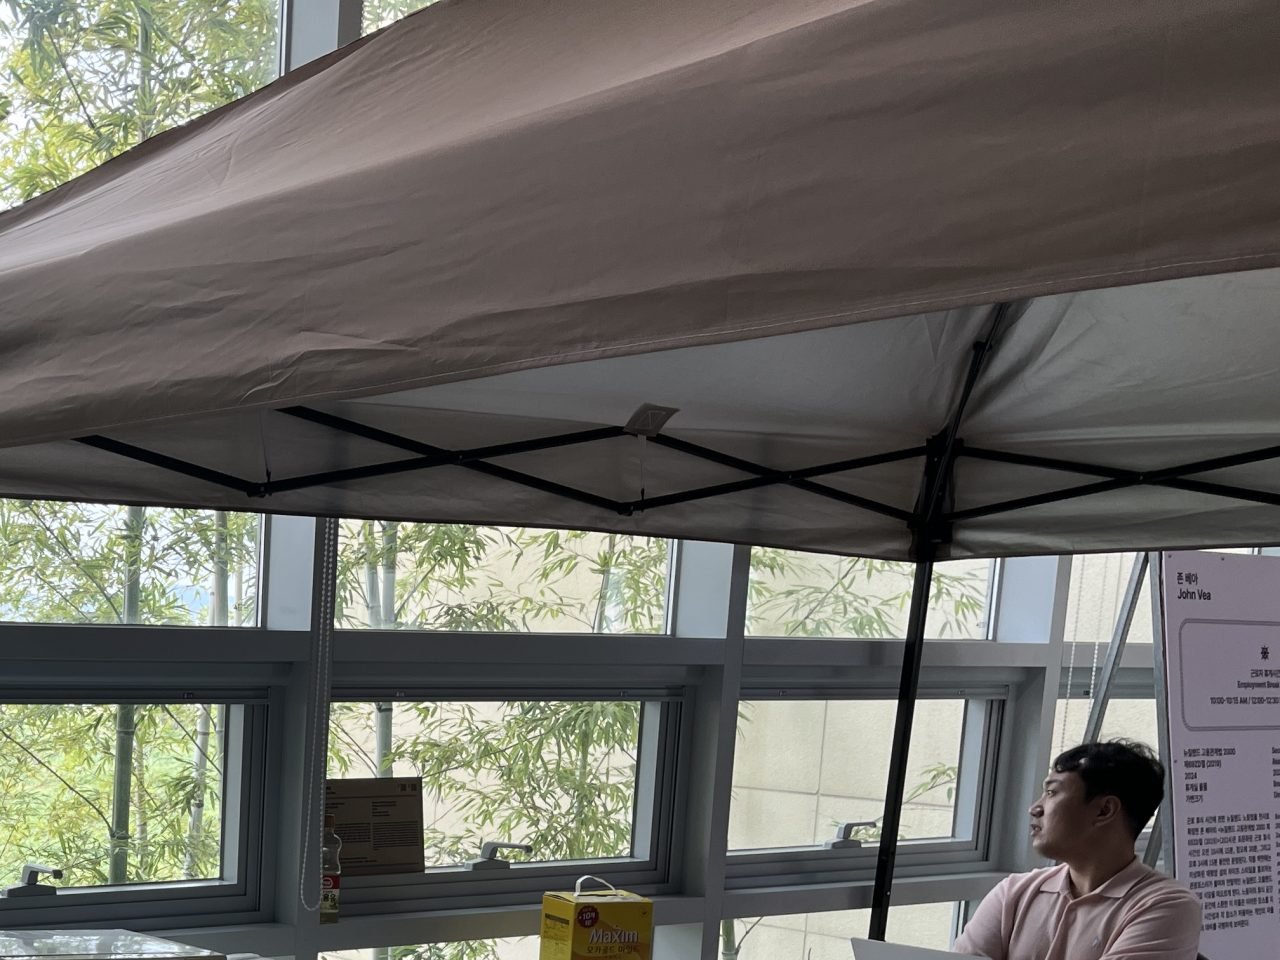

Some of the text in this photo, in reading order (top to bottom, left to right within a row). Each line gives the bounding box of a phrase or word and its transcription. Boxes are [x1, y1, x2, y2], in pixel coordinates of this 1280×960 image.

[1177, 589, 1212, 600] John Vea
[589, 928, 639, 944] Maxim
